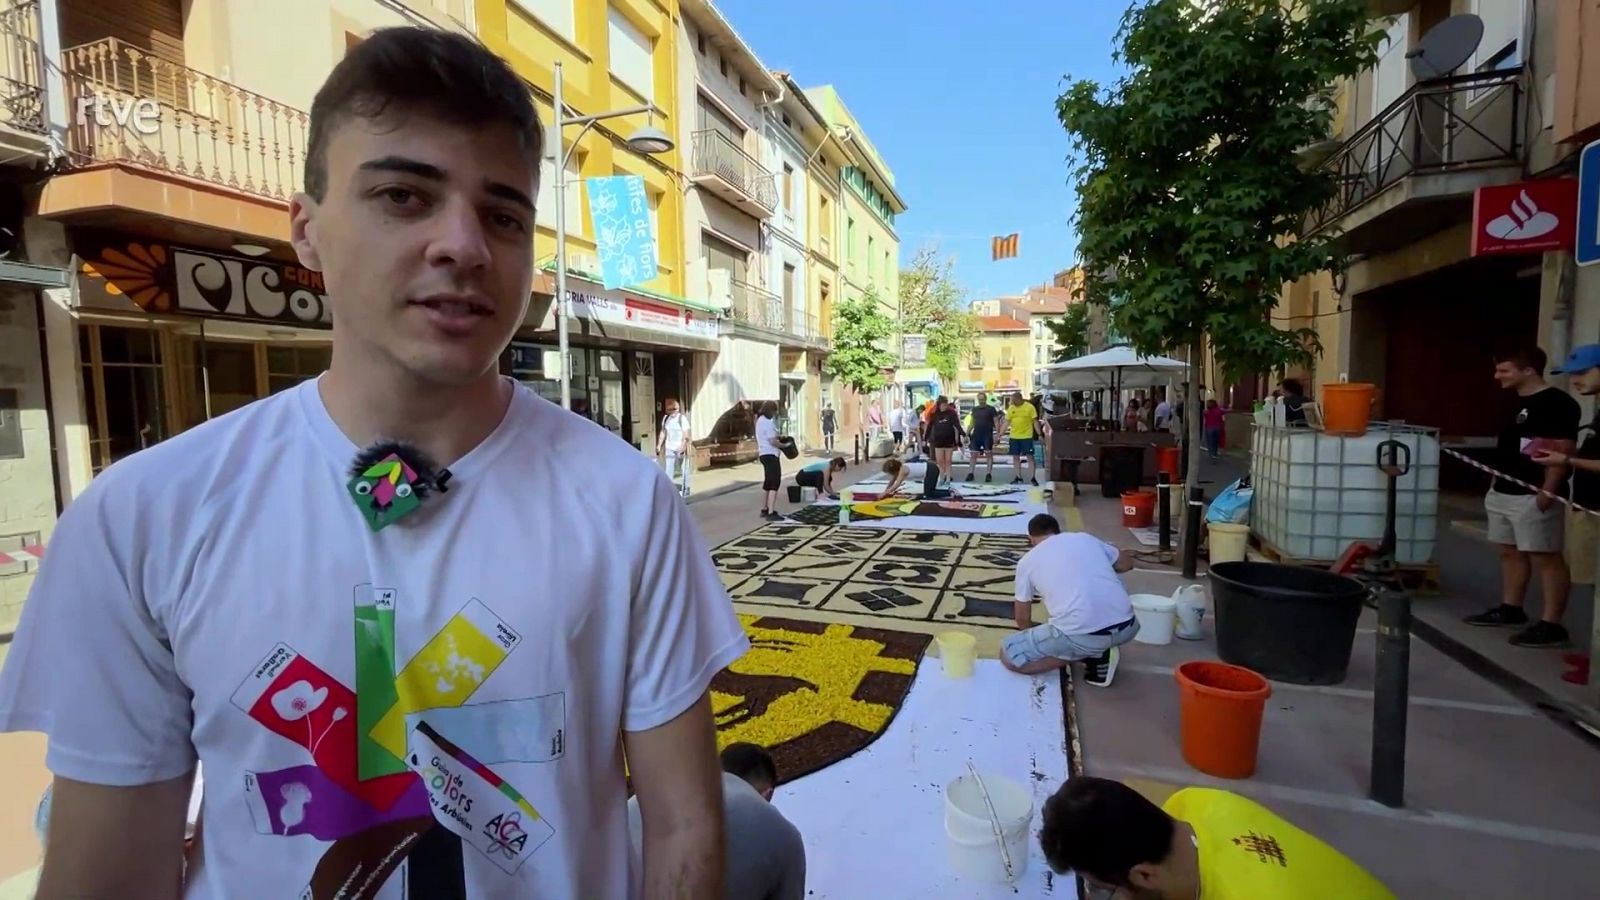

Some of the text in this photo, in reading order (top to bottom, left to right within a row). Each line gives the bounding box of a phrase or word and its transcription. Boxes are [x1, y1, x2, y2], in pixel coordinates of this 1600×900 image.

[625, 174, 645, 215] tifes
[634, 219, 649, 239] de
[484, 812, 529, 852] ACA
